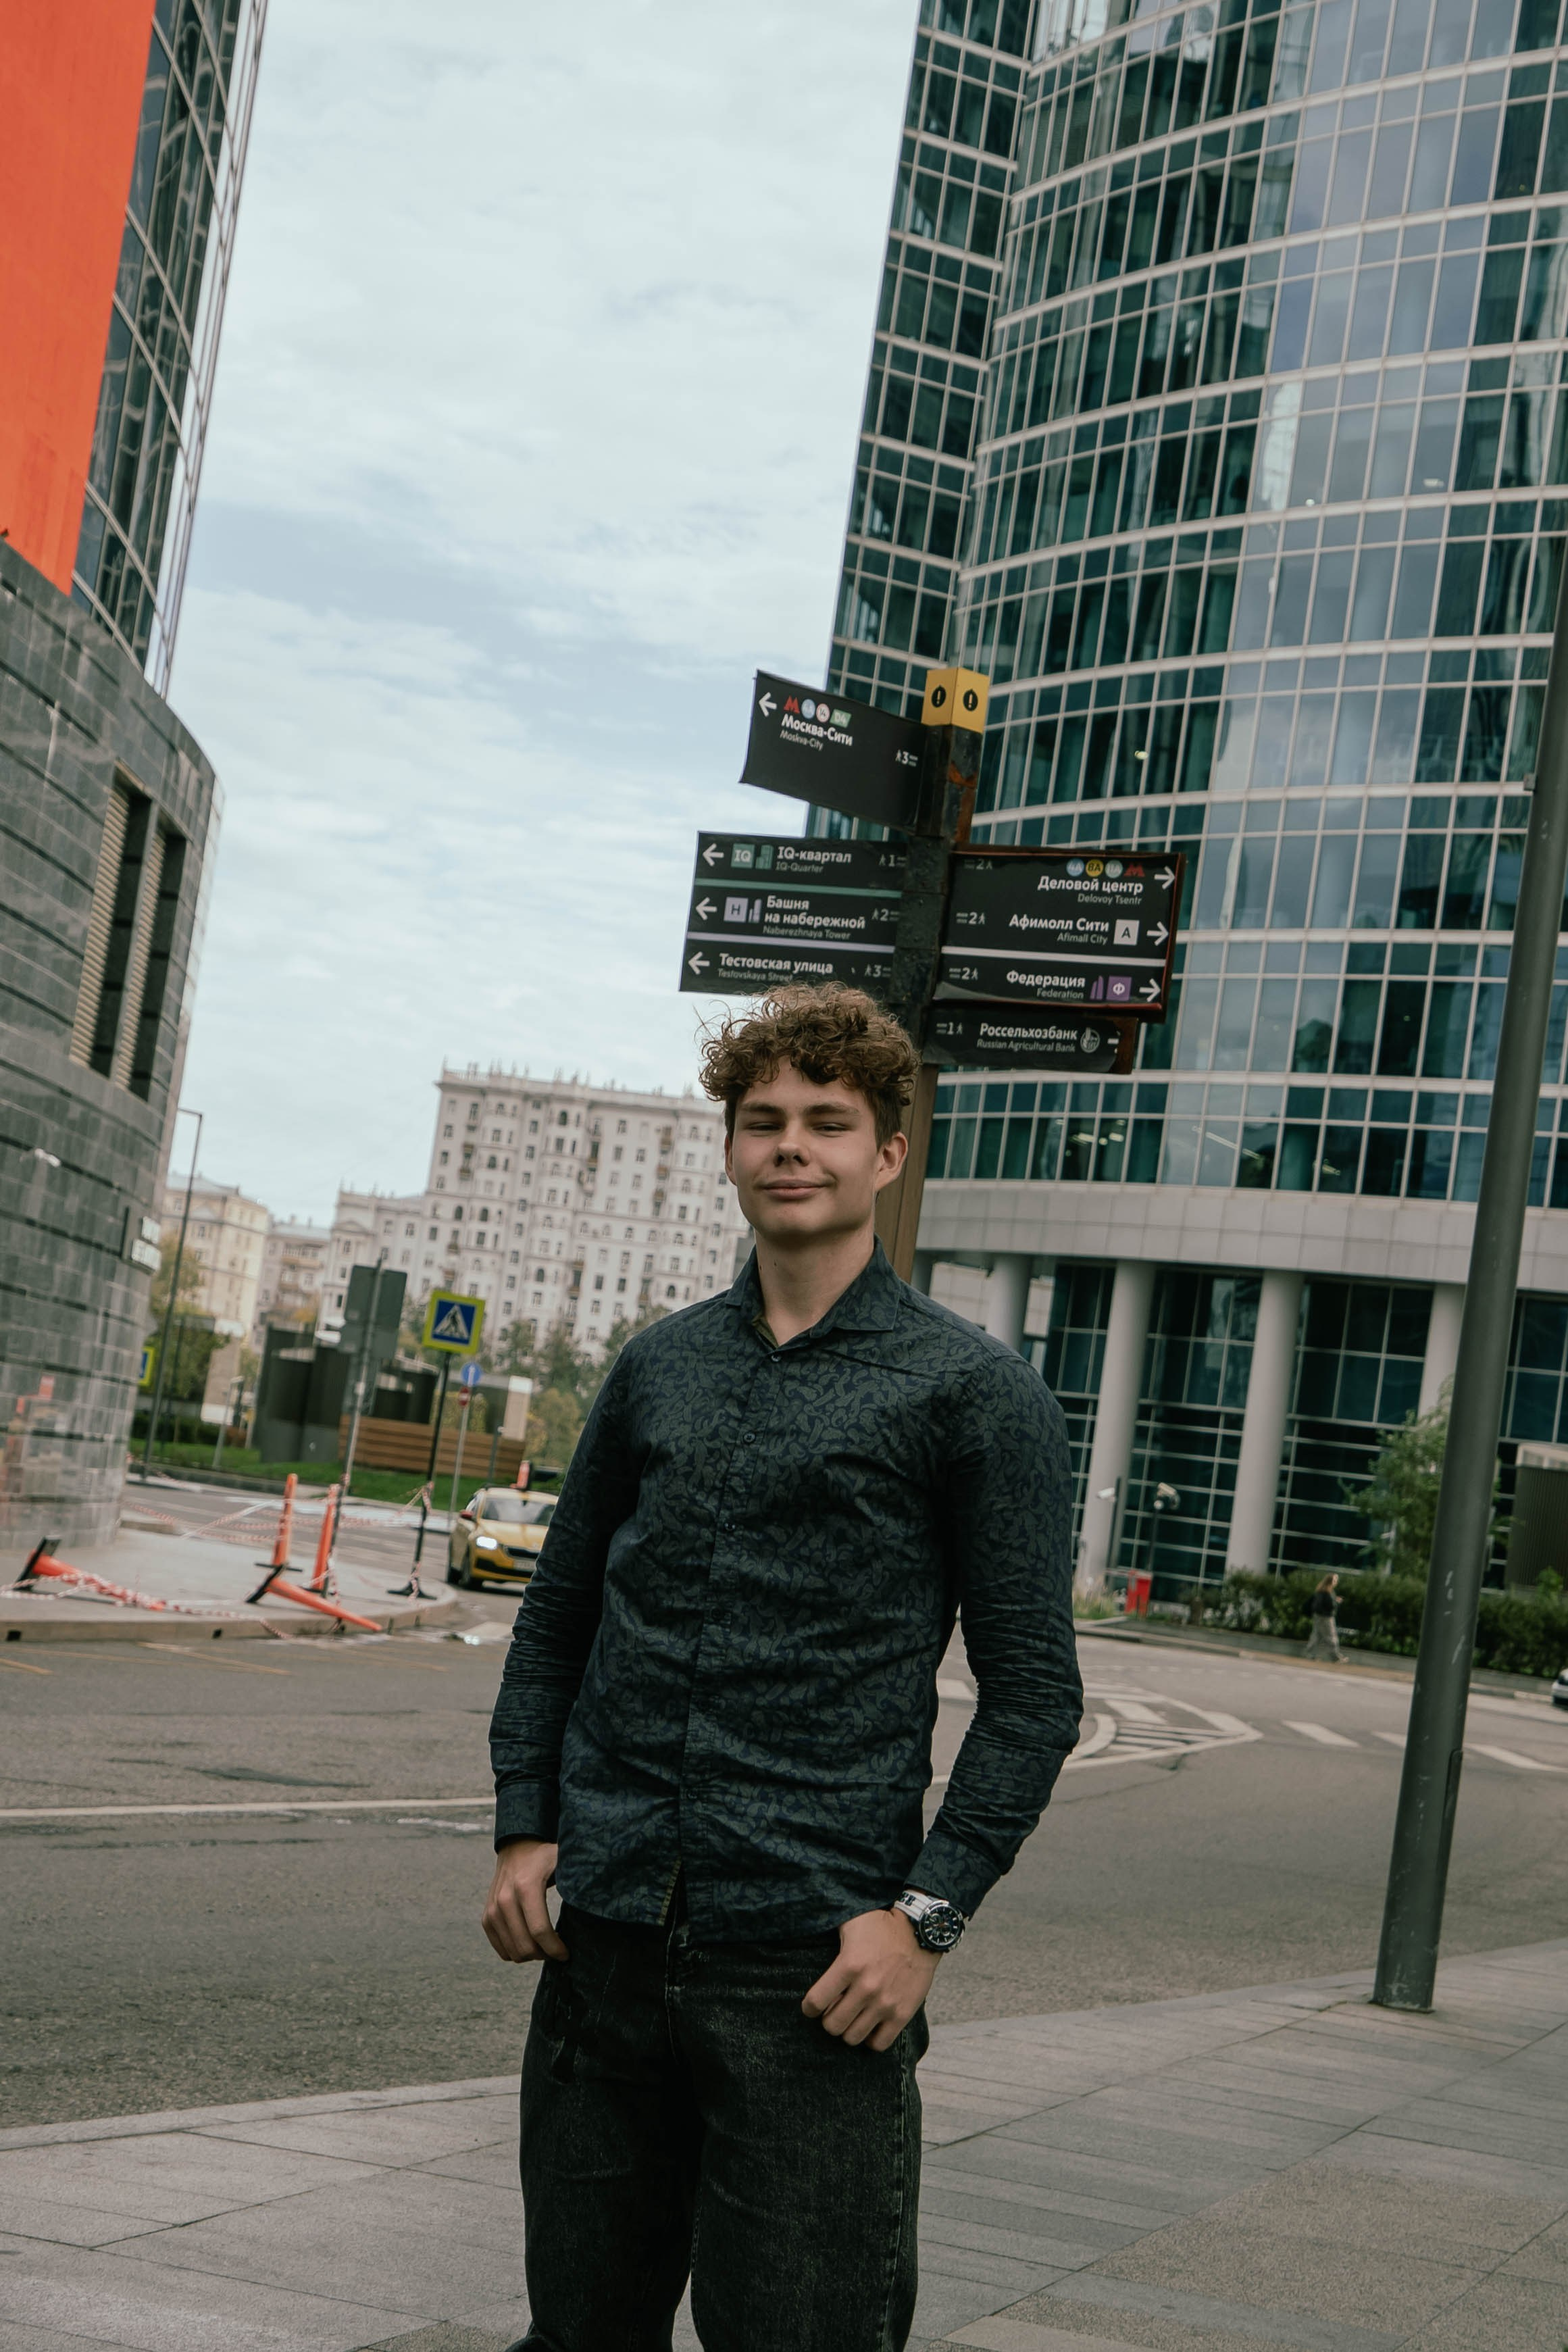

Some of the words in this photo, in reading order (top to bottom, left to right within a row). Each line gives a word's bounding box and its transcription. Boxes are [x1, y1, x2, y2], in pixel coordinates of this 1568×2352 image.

[781, 713, 853, 746] Москва-Сити
[901, 751, 909, 765] 3
[734, 849, 752, 862] IQ
[777, 846, 852, 864] IQ-квартал
[888, 854, 895, 867] 1
[775, 860, 824, 874] IQ-Quarter
[1037, 876, 1099, 892] Деловой
[1102, 880, 1144, 895] центр
[767, 895, 809, 910] Башня
[1078, 893, 1113, 905] Delovoy
[1115, 895, 1142, 905] Tsentr
[764, 913, 780, 923] на
[783, 914, 865, 930] набережной
[880, 909, 888, 922] 2
[969, 911, 978, 925] 2
[1009, 914, 1073, 930] Афимолл
[1076, 918, 1109, 932] Сити
[762, 925, 824, 939] Naberezhnaya
[825, 929, 851, 941] Tower
[1057, 933, 1088, 943] Afimall
[1090, 934, 1108, 946] City
[719, 953, 790, 970] Тестовская
[792, 959, 834, 974] улица
[717, 968, 766, 981] Testovskaya
[873, 964, 882, 978] 3
[961, 967, 970, 980] 2
[1006, 970, 1086, 988] Федерация
[1036, 988, 1084, 999] Federation
[1112, 982, 1126, 996] Ф
[947, 1022, 954, 1035] 1
[980, 1022, 1078, 1041] Россельхозбанк
[977, 1039, 1007, 1049] Russian
[1008, 1041, 1054, 1052] Agricultural
[1055, 1043, 1076, 1053] Bank
